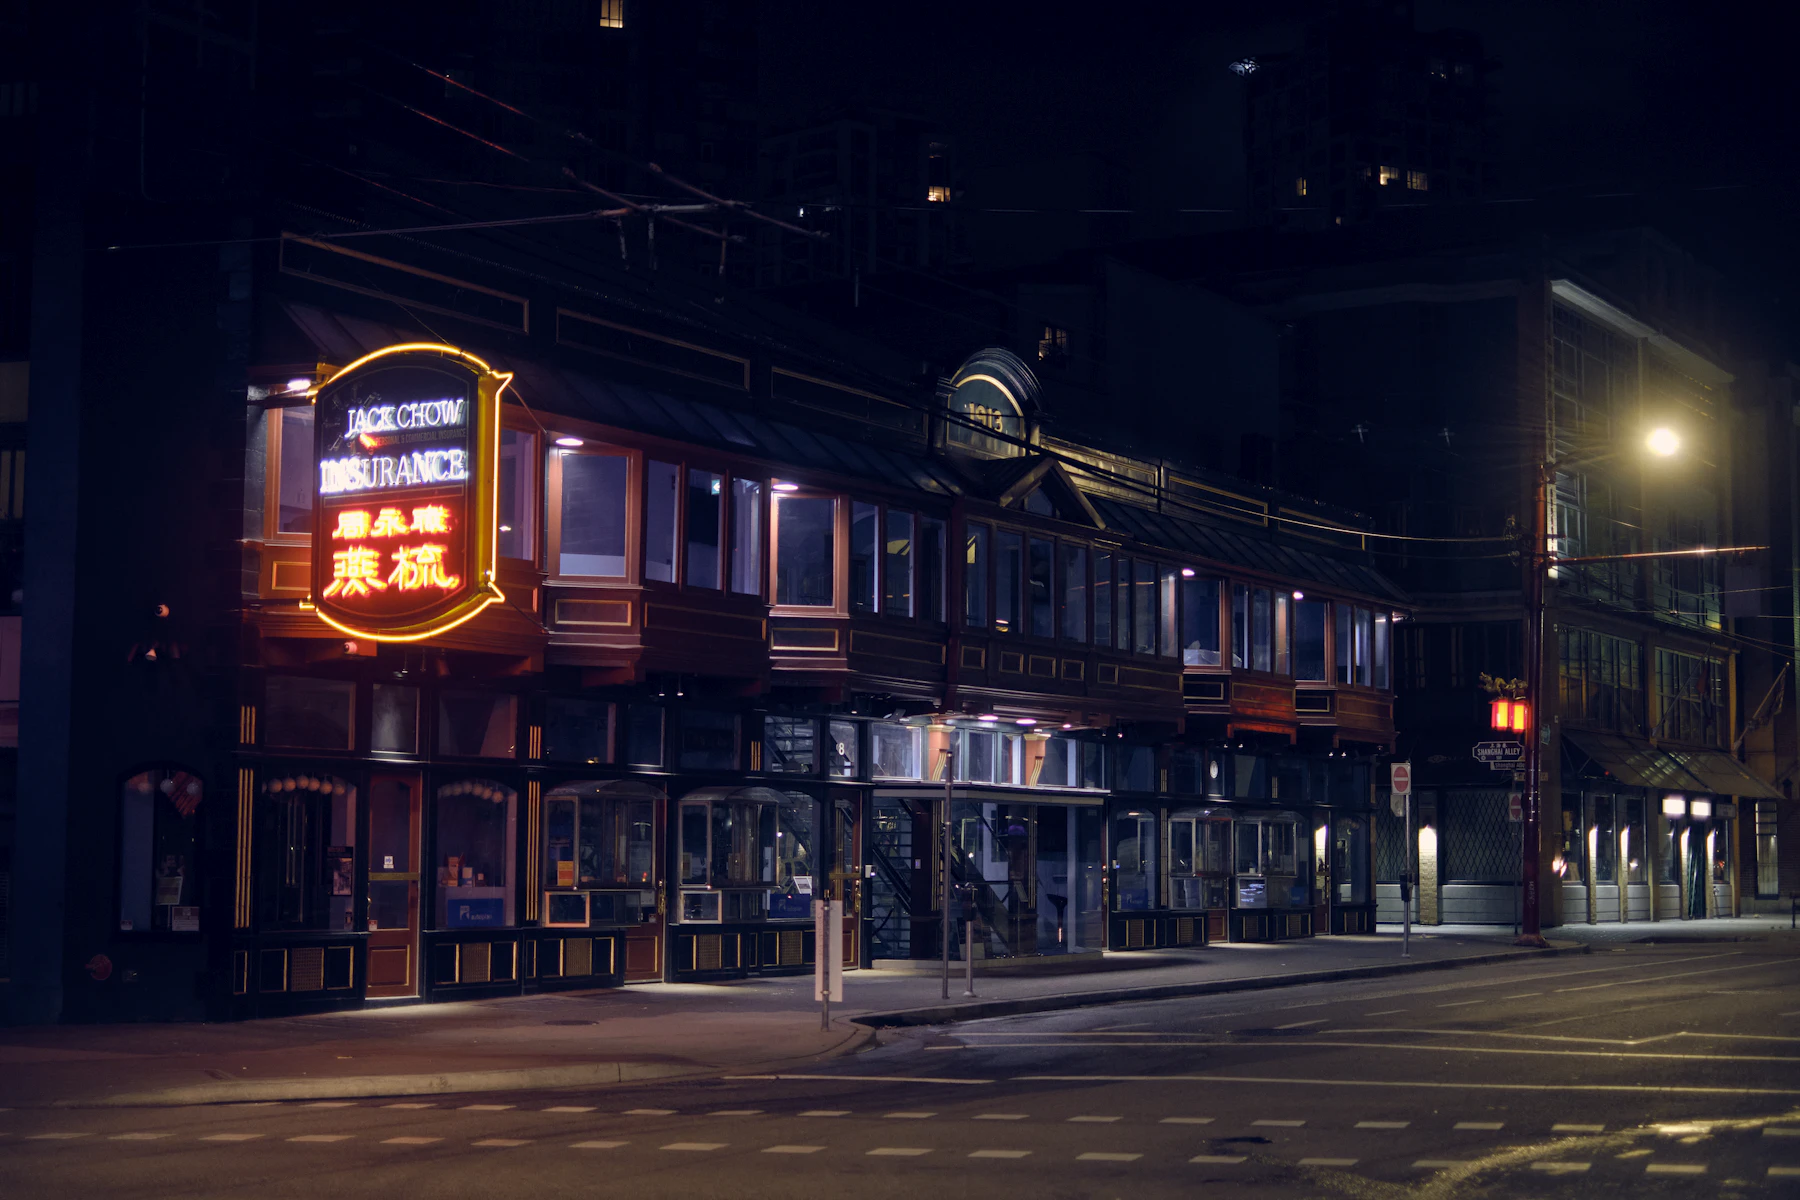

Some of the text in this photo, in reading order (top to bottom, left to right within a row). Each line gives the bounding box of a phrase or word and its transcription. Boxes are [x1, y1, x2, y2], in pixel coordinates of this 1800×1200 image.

[344, 399, 465, 438] JACK CHOW
[969, 403, 1002, 432] 1913
[405, 432, 438, 444] COMMERCIAL
[439, 428, 467, 440] INSURANCE
[319, 450, 468, 493] INSURANCE
[322, 543, 460, 599] 燕梳
[1477, 748, 1503, 756] SHANGHAI
